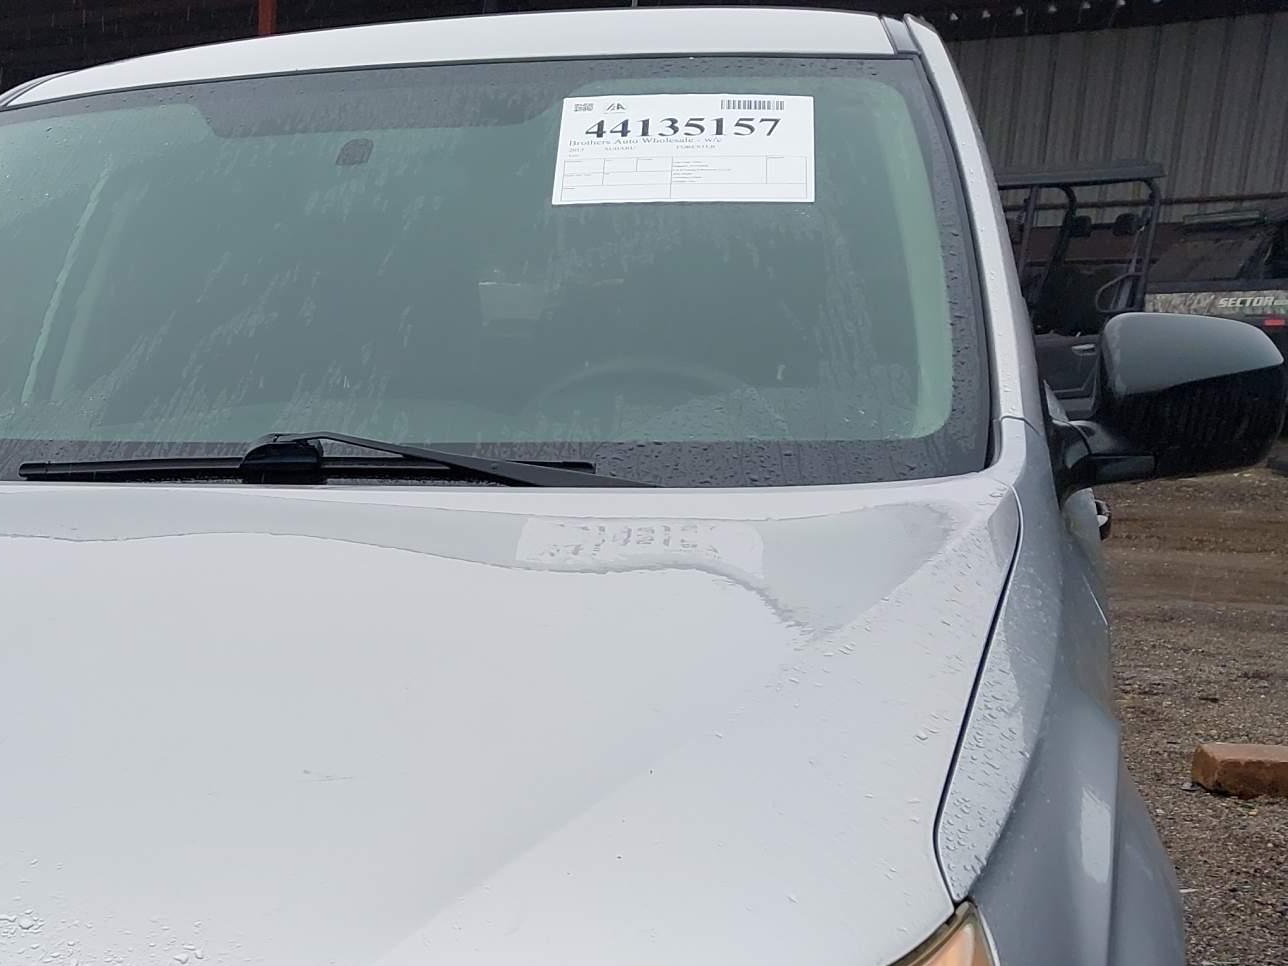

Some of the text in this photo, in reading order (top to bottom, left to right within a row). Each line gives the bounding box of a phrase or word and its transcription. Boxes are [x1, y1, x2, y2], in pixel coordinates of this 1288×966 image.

[584, 116, 782, 138] 44135157
[568, 138, 610, 147] Brothers
[613, 138, 638, 146] Auto
[641, 136, 694, 145] Wholesale
[1218, 296, 1275, 308] SECTOR
